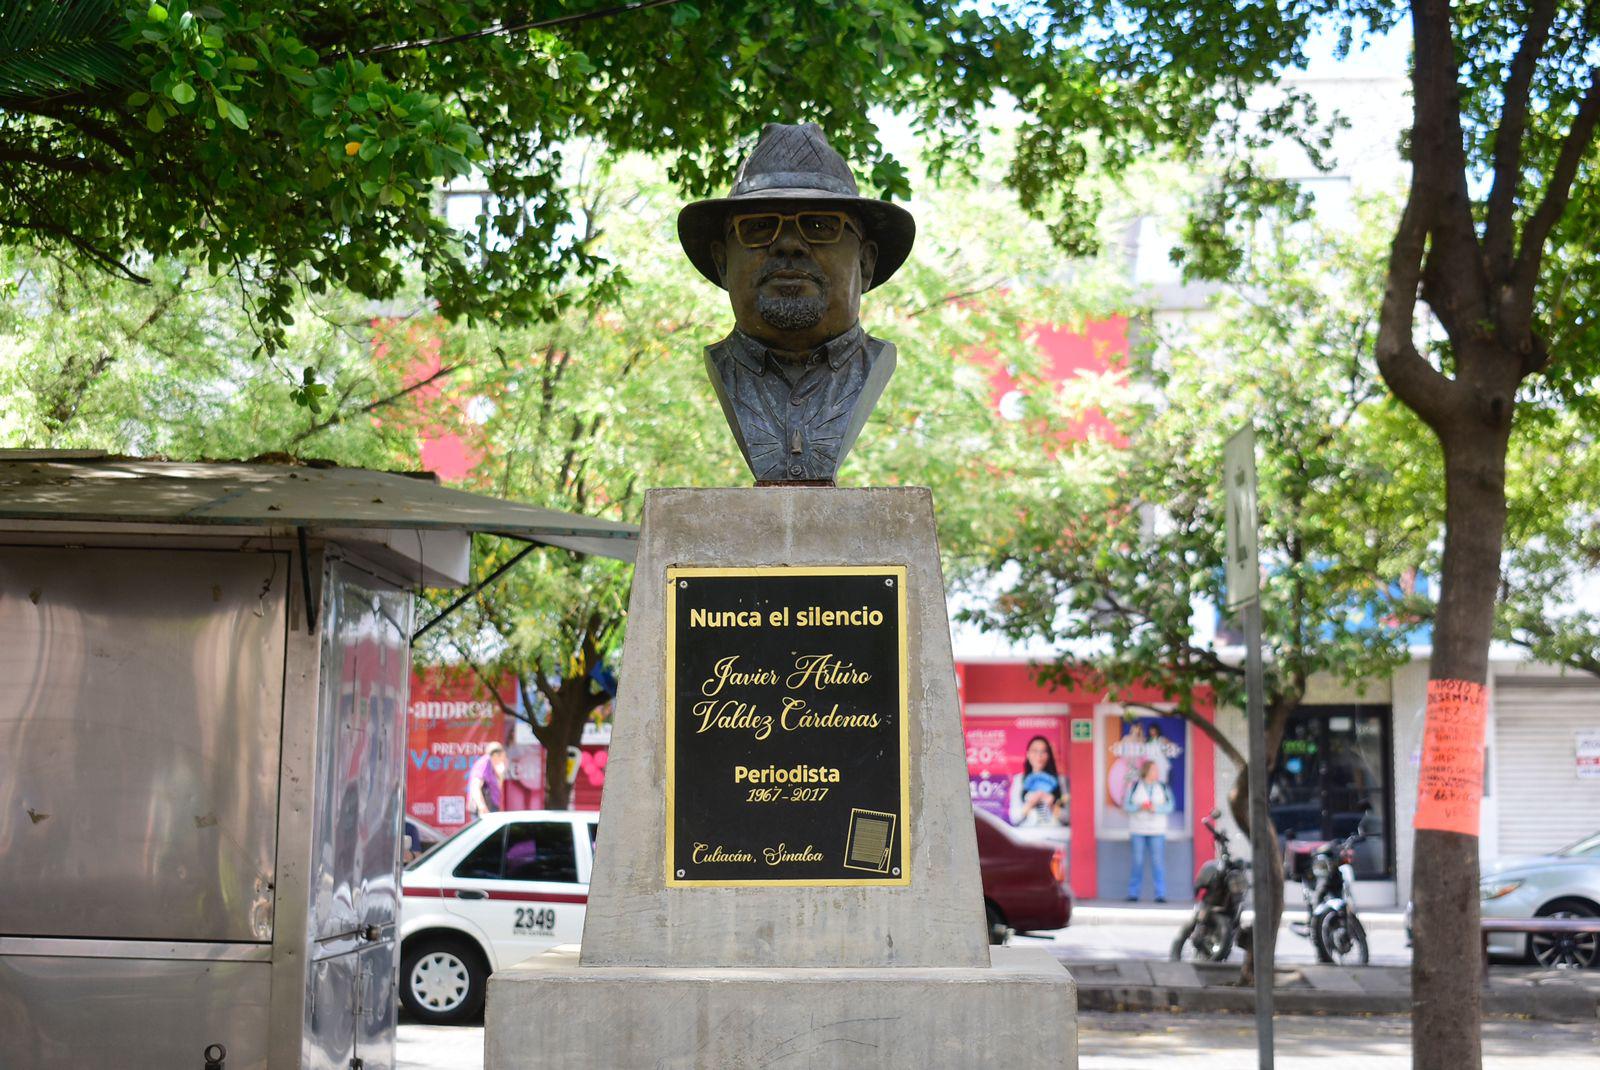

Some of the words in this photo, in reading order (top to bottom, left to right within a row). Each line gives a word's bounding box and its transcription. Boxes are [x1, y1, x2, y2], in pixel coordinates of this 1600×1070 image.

[690, 608, 762, 628] Nunca
[769, 607, 789, 627] el
[796, 606, 884, 627] silencio
[702, 655, 780, 697] Javier
[786, 654, 872, 690] Arturo
[693, 700, 775, 740] Valdez
[780, 697, 881, 731] Cárdenas
[734, 764, 841, 784] Periodista
[746, 787, 829, 802] 1967-2017
[692, 842, 757, 865] Culiacán,
[763, 842, 824, 866] Sinaloa
[515, 907, 555, 929] 2349
